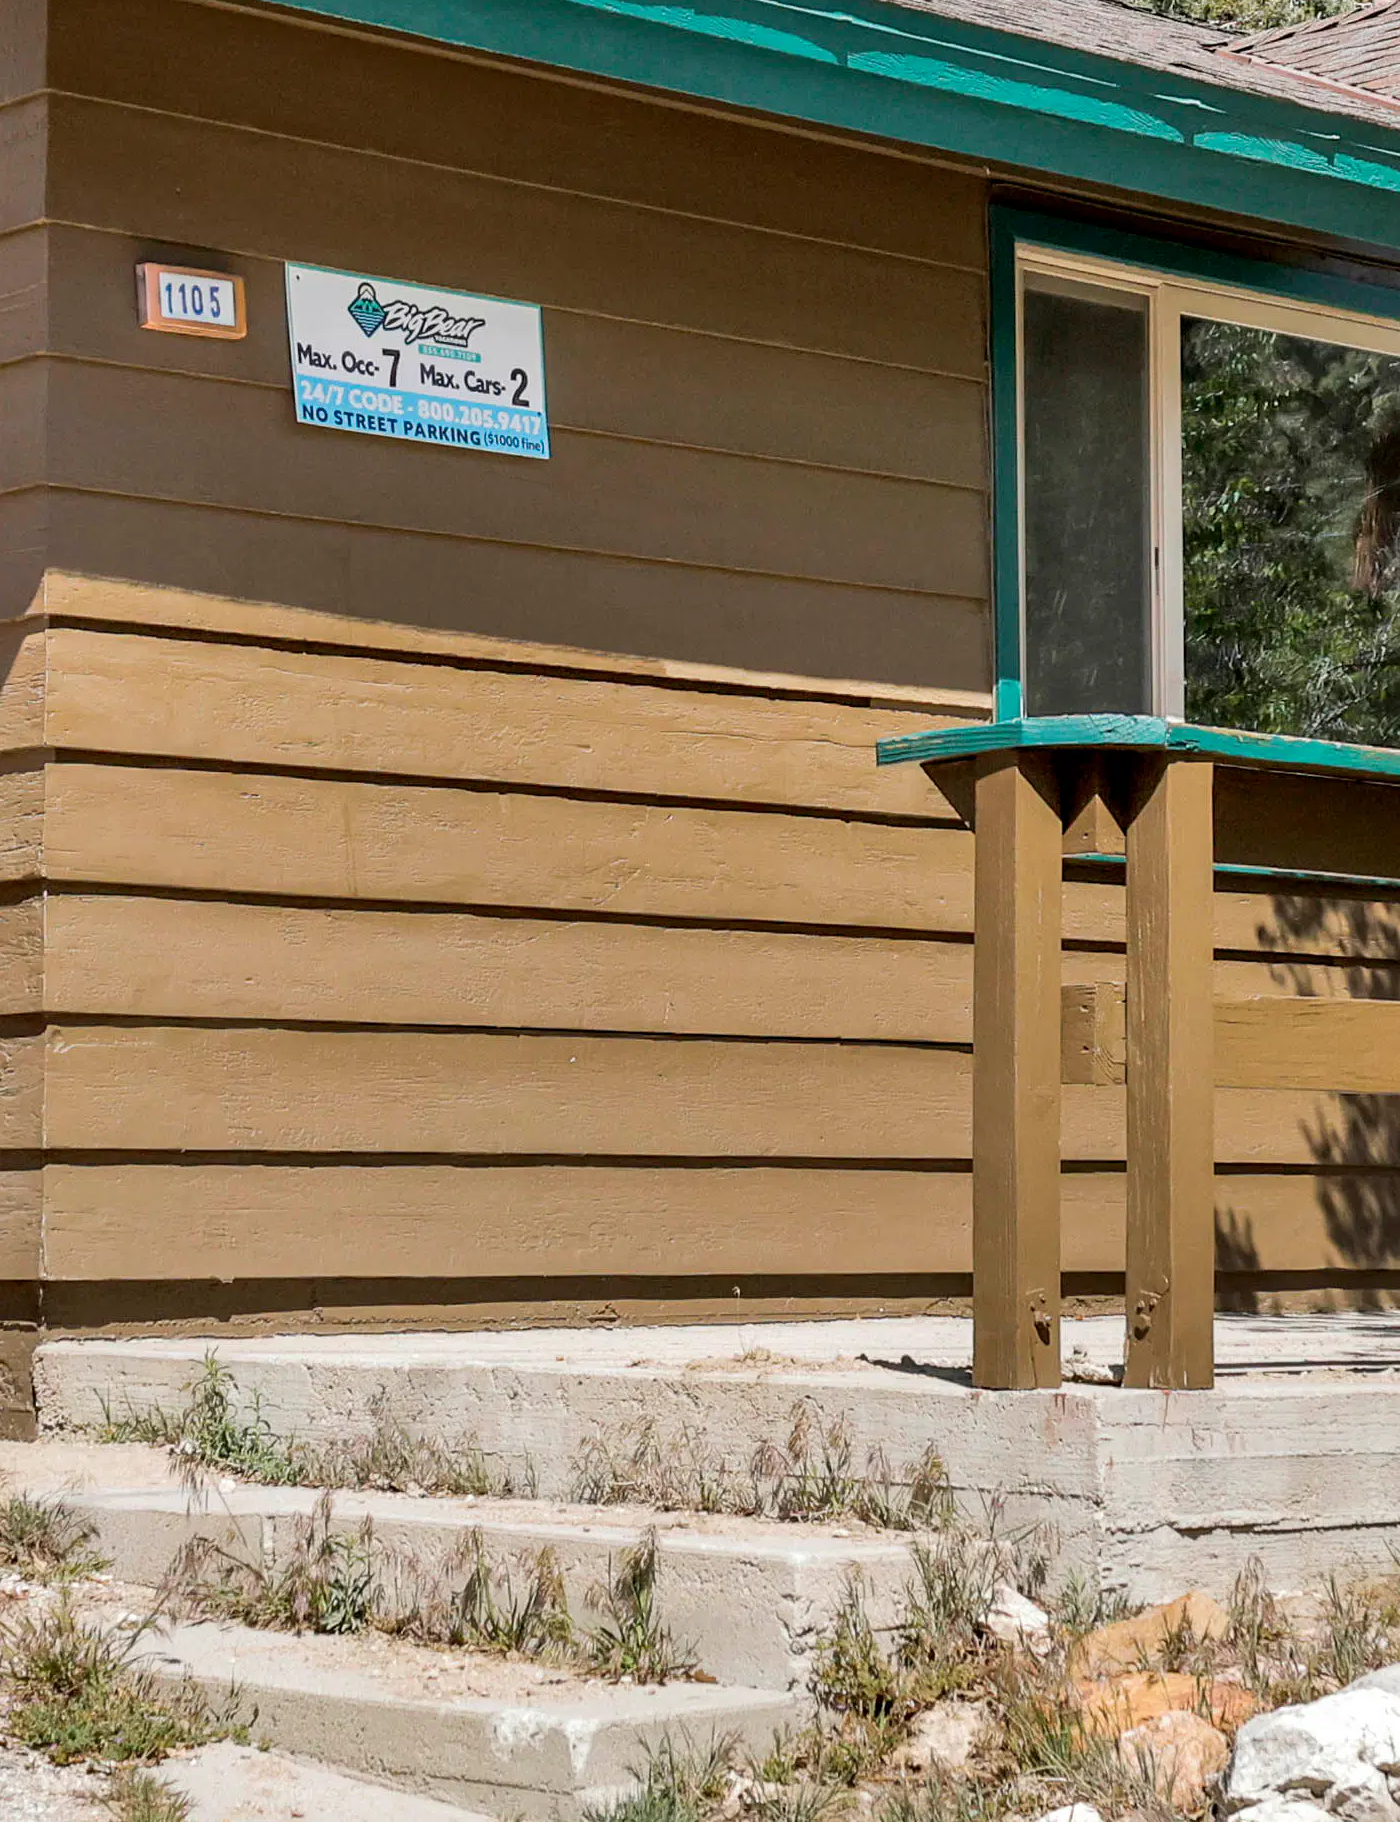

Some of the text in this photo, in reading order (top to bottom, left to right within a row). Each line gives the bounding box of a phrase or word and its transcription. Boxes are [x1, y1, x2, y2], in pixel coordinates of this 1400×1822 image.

[165, 282, 221, 318] 1105
[383, 300, 485, 344] Big Bear
[297, 342, 337, 371] Max.
[341, 351, 380, 377] Occ-
[382, 349, 401, 388] 7
[420, 363, 460, 390] Max.
[464, 370, 507, 397] Cars-
[510, 368, 530, 408] 2
[300, 379, 345, 405] 24/7
[348, 388, 404, 415] CODE
[417, 399, 542, 436] 800.205.9417
[302, 404, 545, 454] NO STREET PARKING ($1000 fine)
